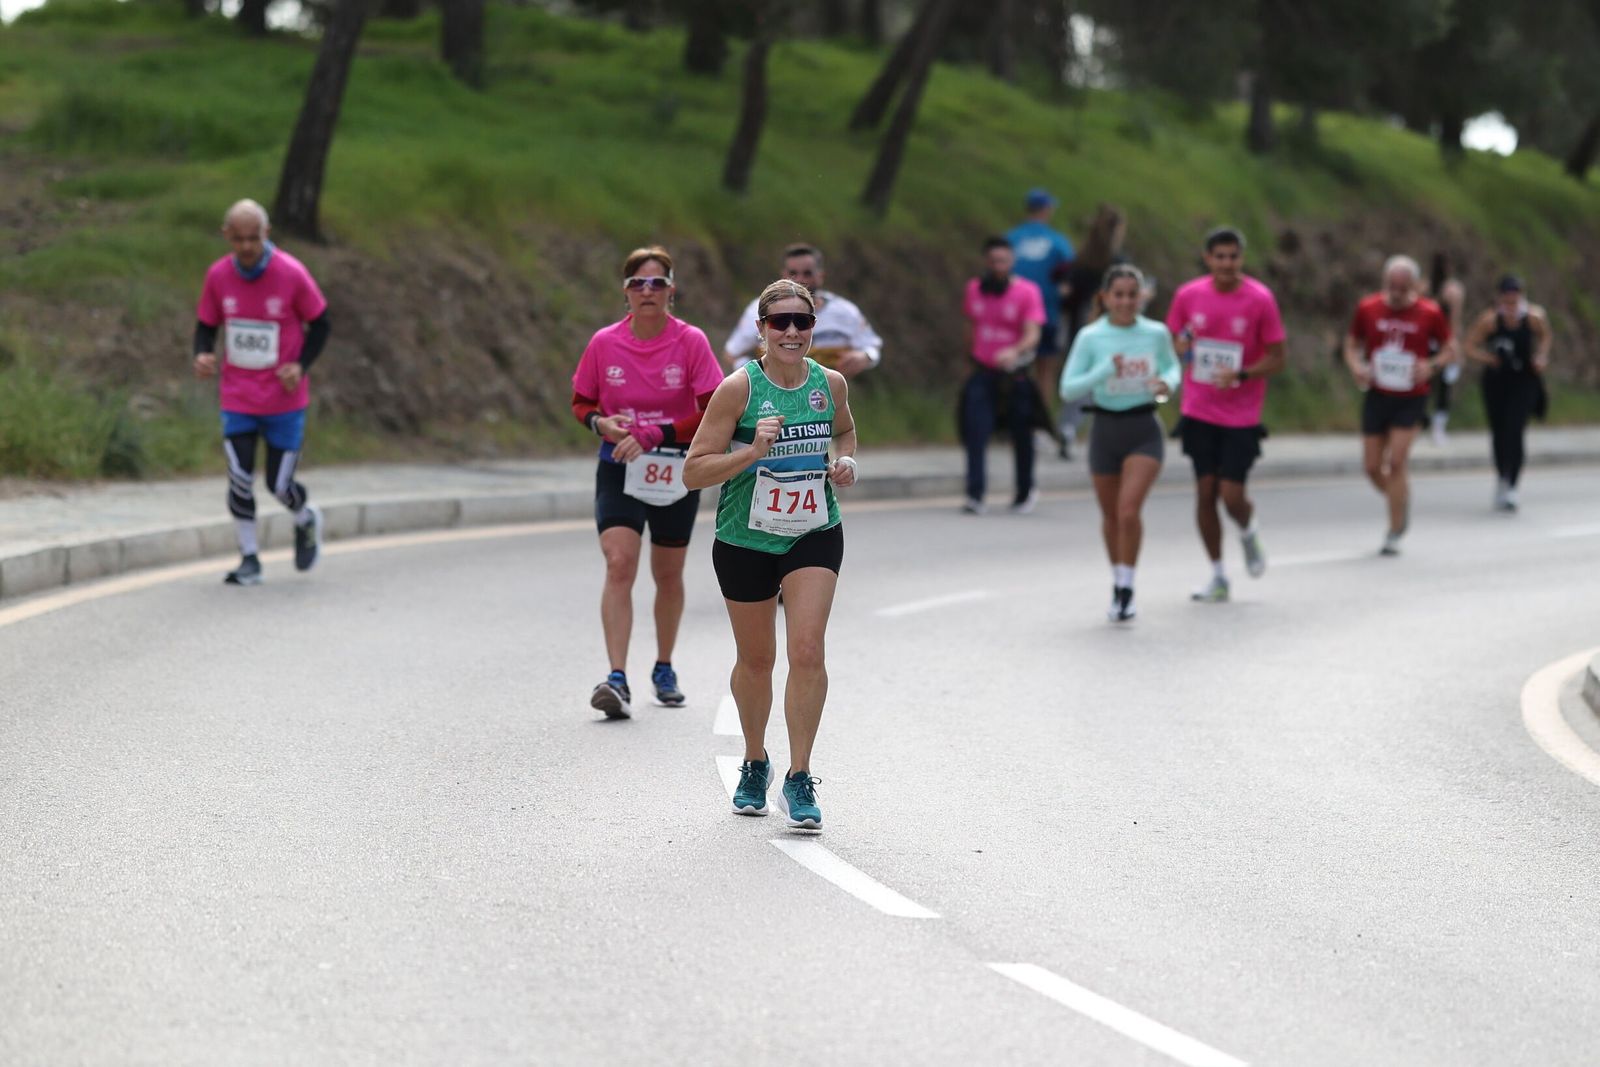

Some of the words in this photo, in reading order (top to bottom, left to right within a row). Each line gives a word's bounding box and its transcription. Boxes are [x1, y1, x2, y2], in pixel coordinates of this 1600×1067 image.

[234, 333, 271, 352] 680
[776, 423, 830, 440] LETISMO
[644, 463, 673, 485] 84
[766, 487, 818, 515] 174
